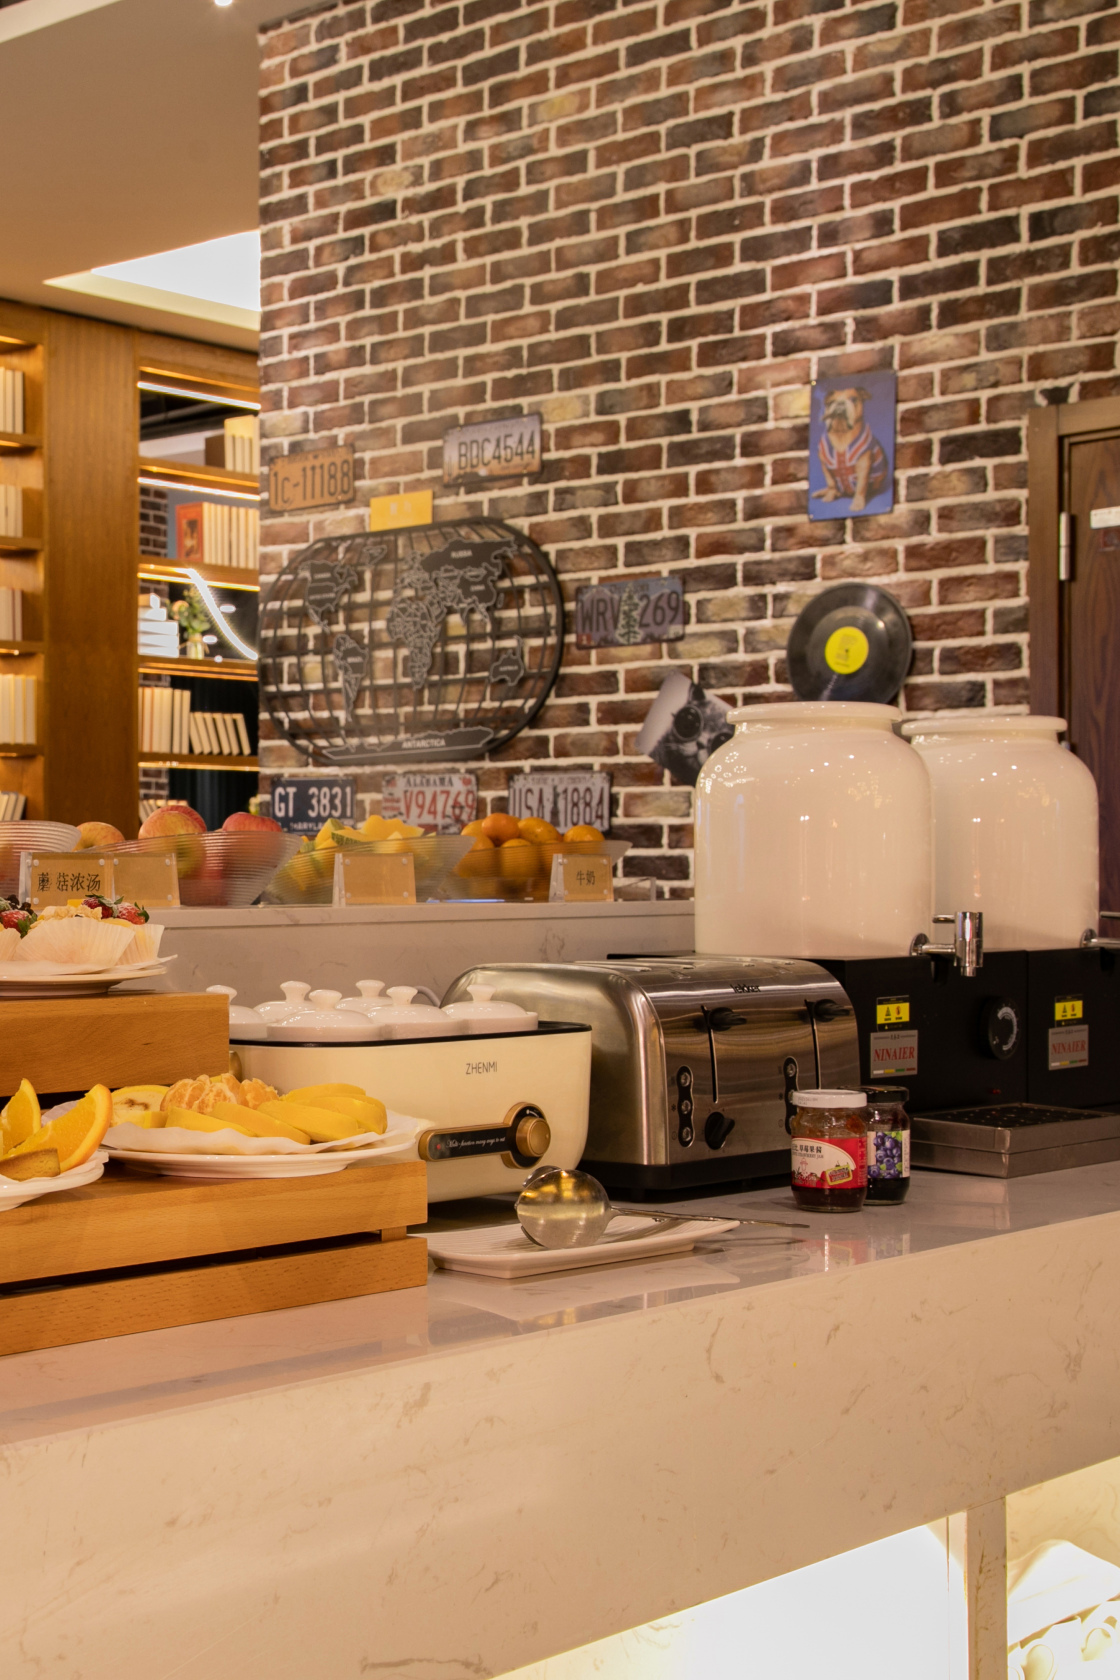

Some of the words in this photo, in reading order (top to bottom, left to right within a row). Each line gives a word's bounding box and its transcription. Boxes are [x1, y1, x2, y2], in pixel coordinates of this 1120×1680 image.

[639, 590, 681, 629] 269
[402, 738, 446, 749] ANTARCTICA
[274, 786, 298, 818] GT
[308, 786, 352, 818] 3831
[512, 788, 545, 820] USA
[562, 787, 605, 827] 1884
[37, 872, 101, 892] 蘑菇浓汤
[576, 870, 596, 886] 牛奶
[873, 1046, 915, 1062] NINAIER
[465, 1061, 498, 1075] ZHENMI
